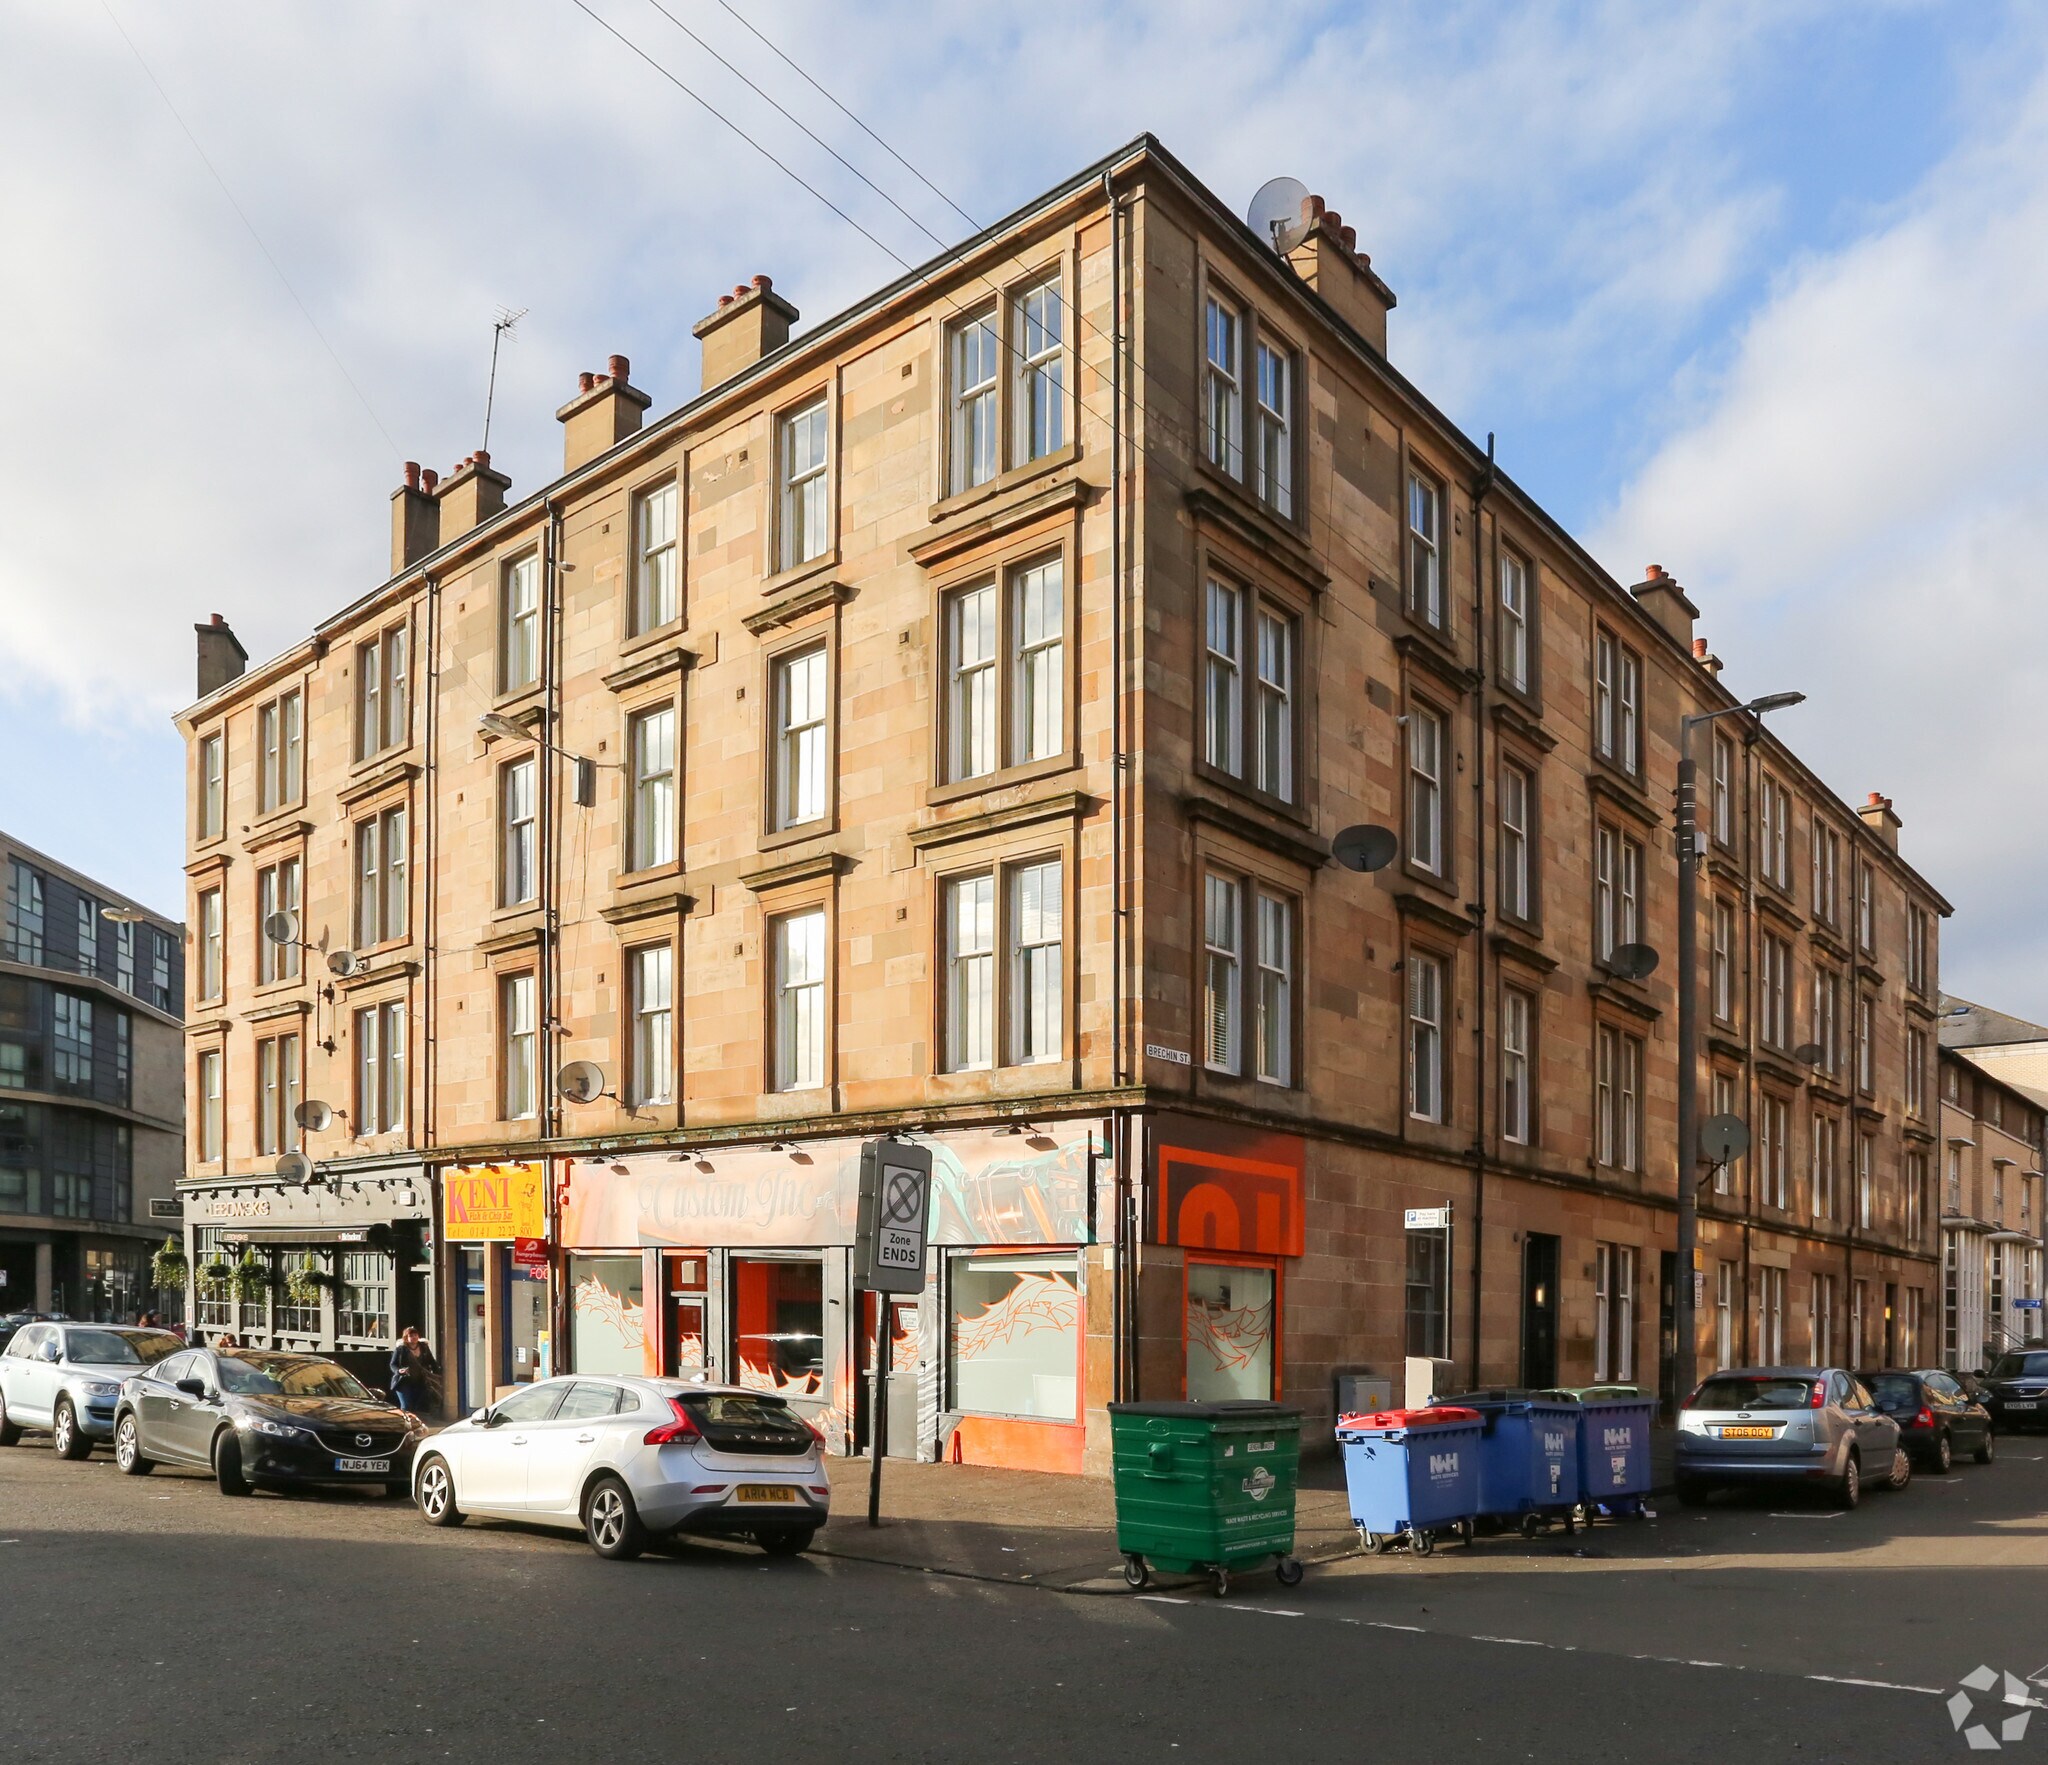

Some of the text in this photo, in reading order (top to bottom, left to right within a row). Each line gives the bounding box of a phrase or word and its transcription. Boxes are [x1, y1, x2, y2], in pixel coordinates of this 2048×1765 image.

[1148, 1045, 1178, 1061] BRECHIN
[447, 1178, 512, 1224] KENT
[469, 1211, 481, 1221] Fish
[489, 1211, 502, 1223] Chip
[503, 1211, 513, 1221] Bar
[470, 1227, 490, 1237] 0141
[520, 1226, 532, 1237] 800
[890, 1233, 911, 1246] Zone
[883, 1247, 916, 1263] ENDS
[734, 1434, 796, 1442] VOLVO
[1725, 1428, 1748, 1437] ST06
[342, 1460, 389, 1470] NJ64 YEK
[1430, 1452, 1459, 1474] NWH
[744, 1488, 767, 1500] AR14
